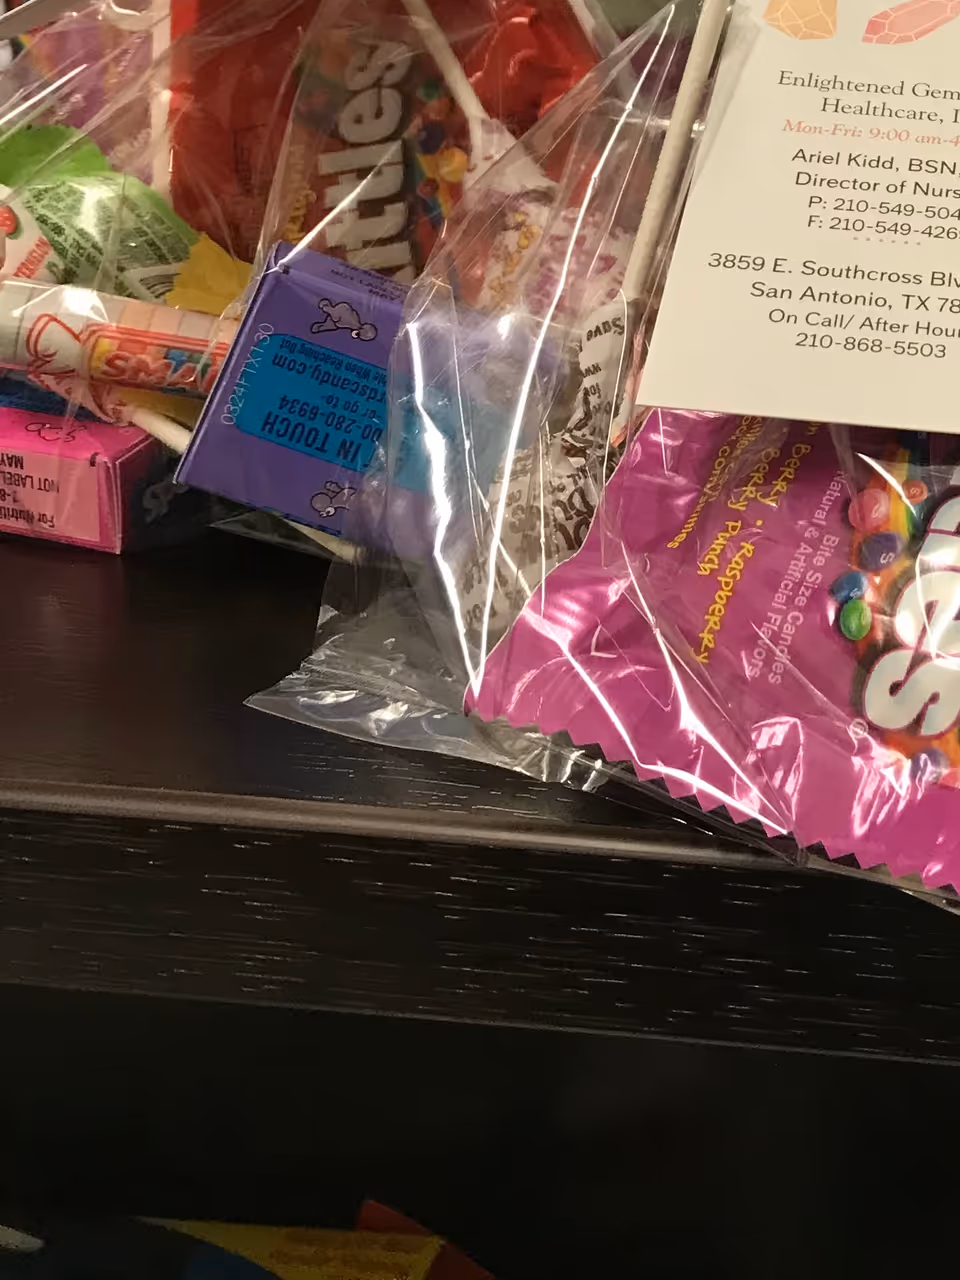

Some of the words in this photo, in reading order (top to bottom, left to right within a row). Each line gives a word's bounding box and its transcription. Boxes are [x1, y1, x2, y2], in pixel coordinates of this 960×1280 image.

[778, 69, 904, 95] Enlightened
[820, 96, 944, 124] Healthcare,
[781, 118, 863, 139] Mon-Fri:
[868, 126, 910, 143] 9:00
[791, 149, 841, 166] Ariel
[847, 153, 900, 172] Kidd,
[795, 171, 880, 194] Director
[885, 179, 907, 195] of
[808, 195, 828, 210] P:
[807, 214, 824, 230] F:
[707, 252, 766, 272] 3859
[772, 258, 793, 274] E.
[801, 260, 923, 285] Southcross
[749, 281, 793, 301] San
[799, 285, 894, 311] Antonio,
[902, 293, 931, 311] TX
[586, 316, 625, 342] Save
[768, 308, 799, 325] On
[804, 309, 855, 331] Call/
[860, 316, 910, 335] After
[279, 337, 297, 354] Out
[298, 341, 344, 370] Reaching
[794, 331, 948, 359] 210-868-5503
[343, 359, 370, 381] When
[342, 401, 360, 414] go
[260, 410, 330, 454] TOUCH
[0, 452, 25, 470] MAY
[336, 438, 363, 464] IN
[813, 469, 845, 527] Natural
[0, 504, 34, 526] Nutriti
[36, 510, 55, 529] For
[696, 519, 742, 577] Punch
[812, 533, 841, 568] Bite
[770, 542, 815, 611] Artificial
[793, 570, 824, 607] Size
[767, 612, 805, 685] Candies
